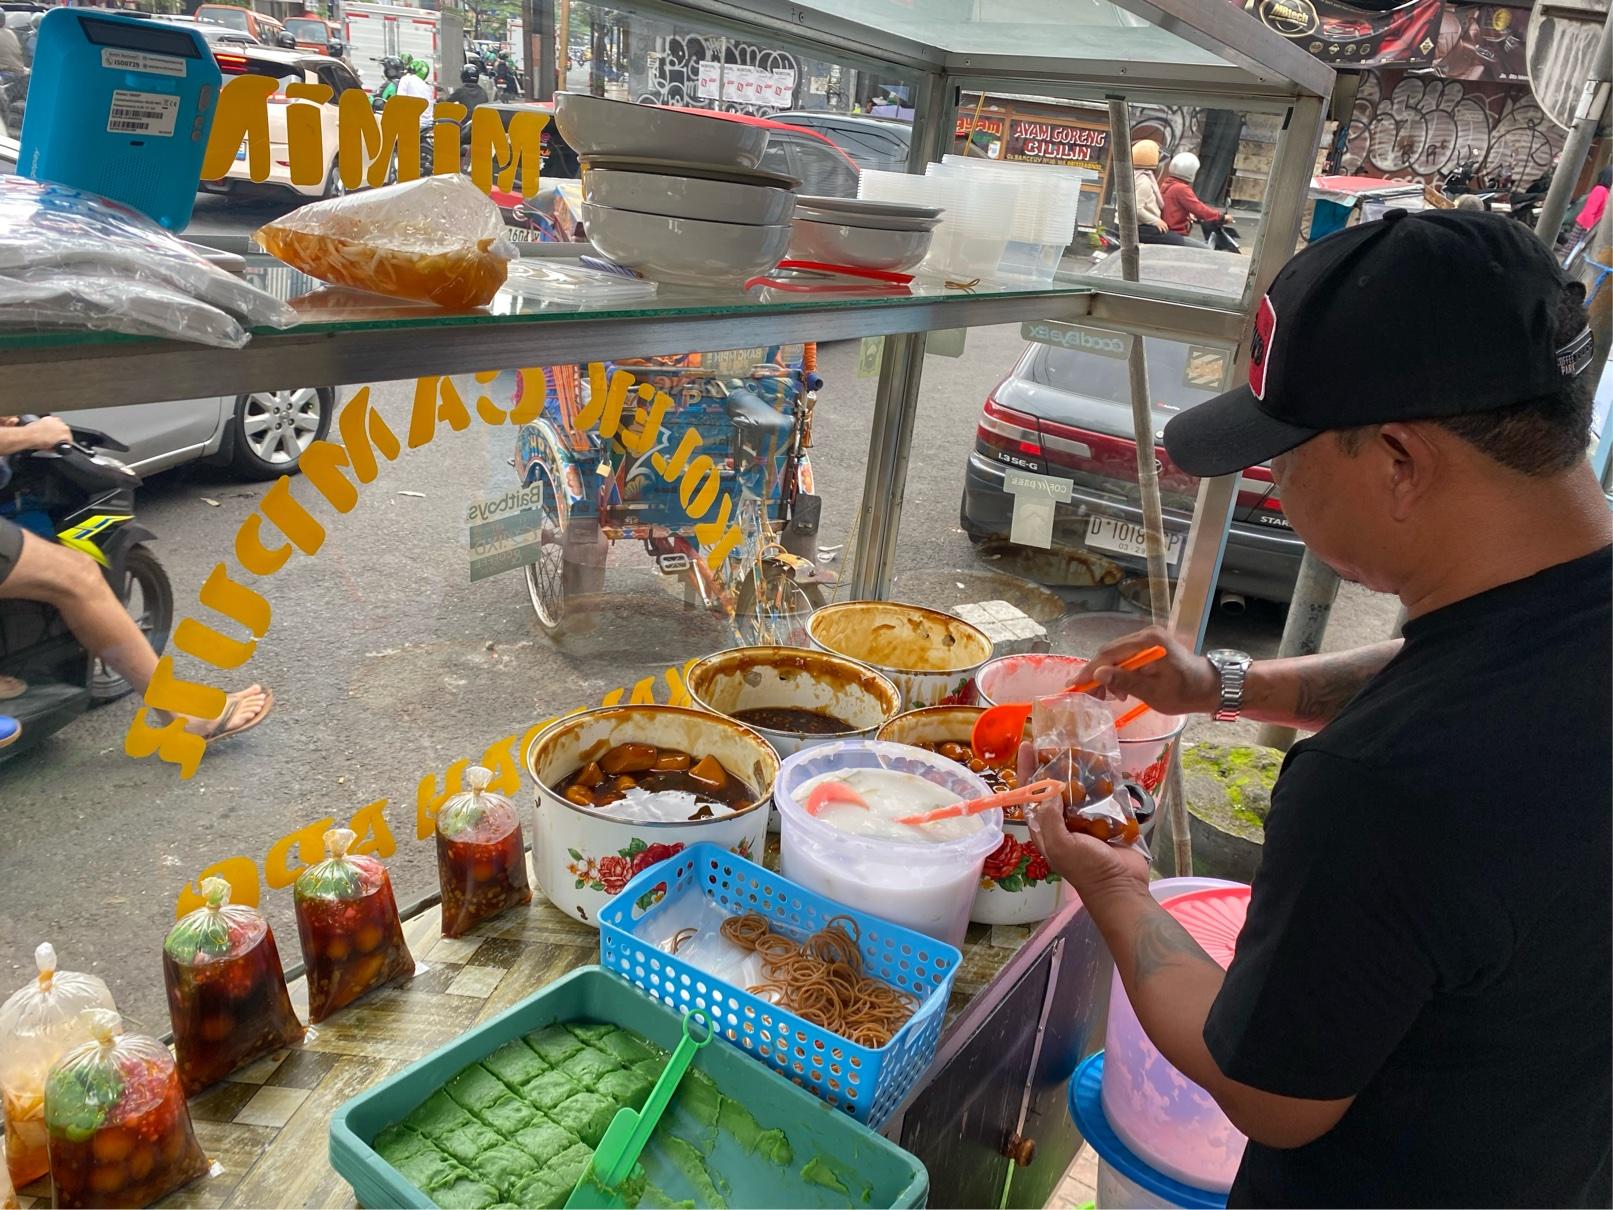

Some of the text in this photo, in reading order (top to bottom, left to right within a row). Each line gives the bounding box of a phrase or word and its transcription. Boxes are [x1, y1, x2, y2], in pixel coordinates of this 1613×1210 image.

[1271, 2, 1309, 23] MBtech
[1014, 122, 1051, 141] AYAM
[1052, 128, 1106, 147] GORENG
[1024, 140, 1091, 161] CILILIN
[1091, 517, 1103, 535] D
[1112, 522, 1145, 545] 1018
